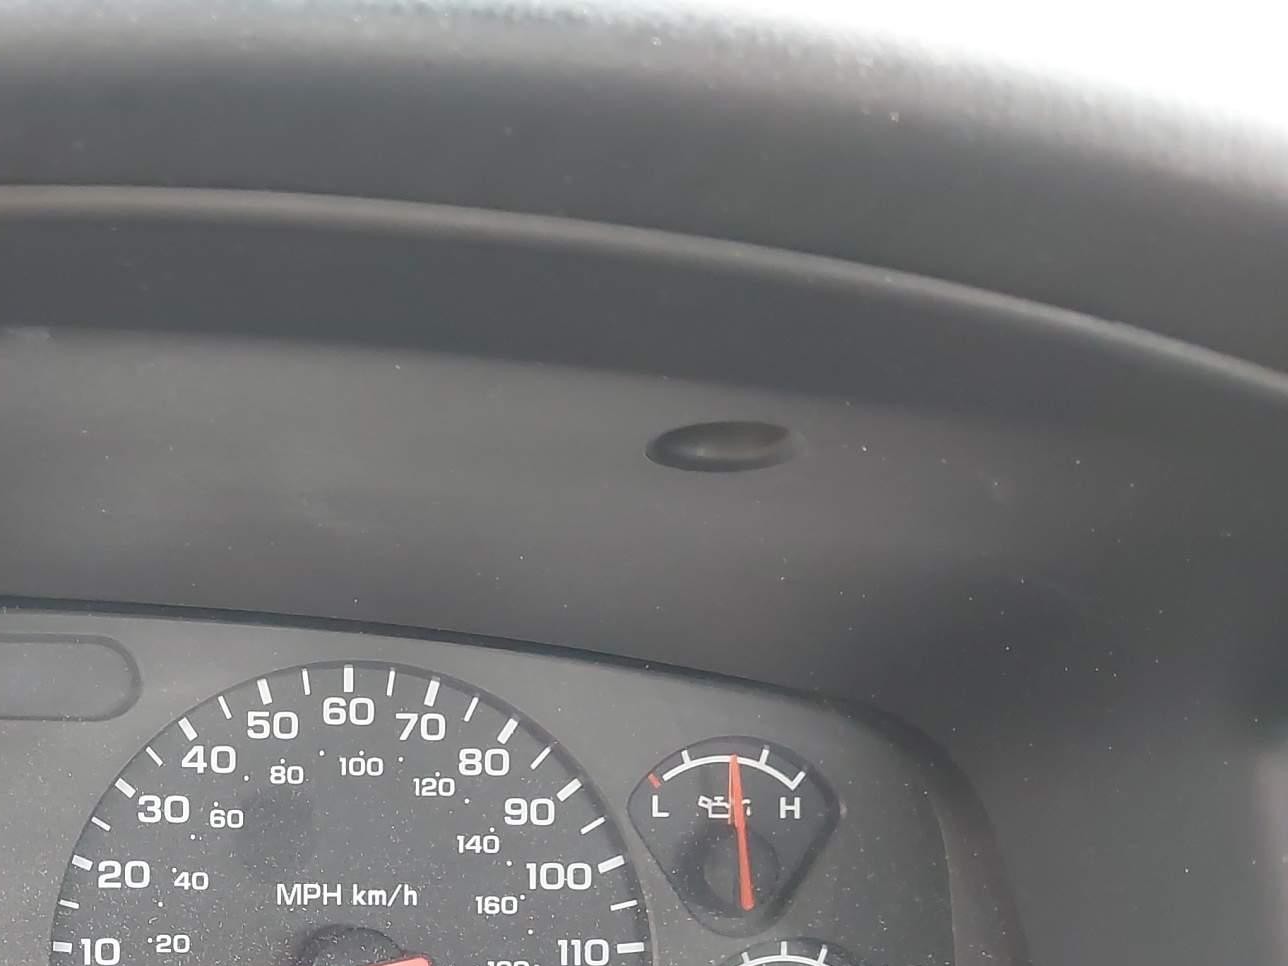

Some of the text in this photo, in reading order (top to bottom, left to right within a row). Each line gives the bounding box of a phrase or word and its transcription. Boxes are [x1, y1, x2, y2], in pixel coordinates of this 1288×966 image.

[247, 711, 300, 739] 50
[322, 698, 375, 726] 60
[395, 713, 447, 741] 70
[181, 746, 237, 774] 40
[339, 757, 384, 776] 100
[458, 748, 510, 776] 80
[269, 765, 304, 785] 80
[413, 778, 455, 797] 120
[137, 795, 190, 823] 30
[209, 809, 244, 828] 60
[504, 798, 555, 826] 90
[651, 795, 669, 818] L
[779, 796, 801, 819] H
[457, 834, 500, 854] 140
[97, 860, 151, 889] 20
[173, 871, 209, 891] 40
[526, 862, 592, 891] 100
[276, 883, 418, 908] MPH km/h
[475, 896, 518, 915] 160
[80, 938, 121, 966] 10
[155, 935, 190, 954] 20
[557, 938, 610, 966] 110
